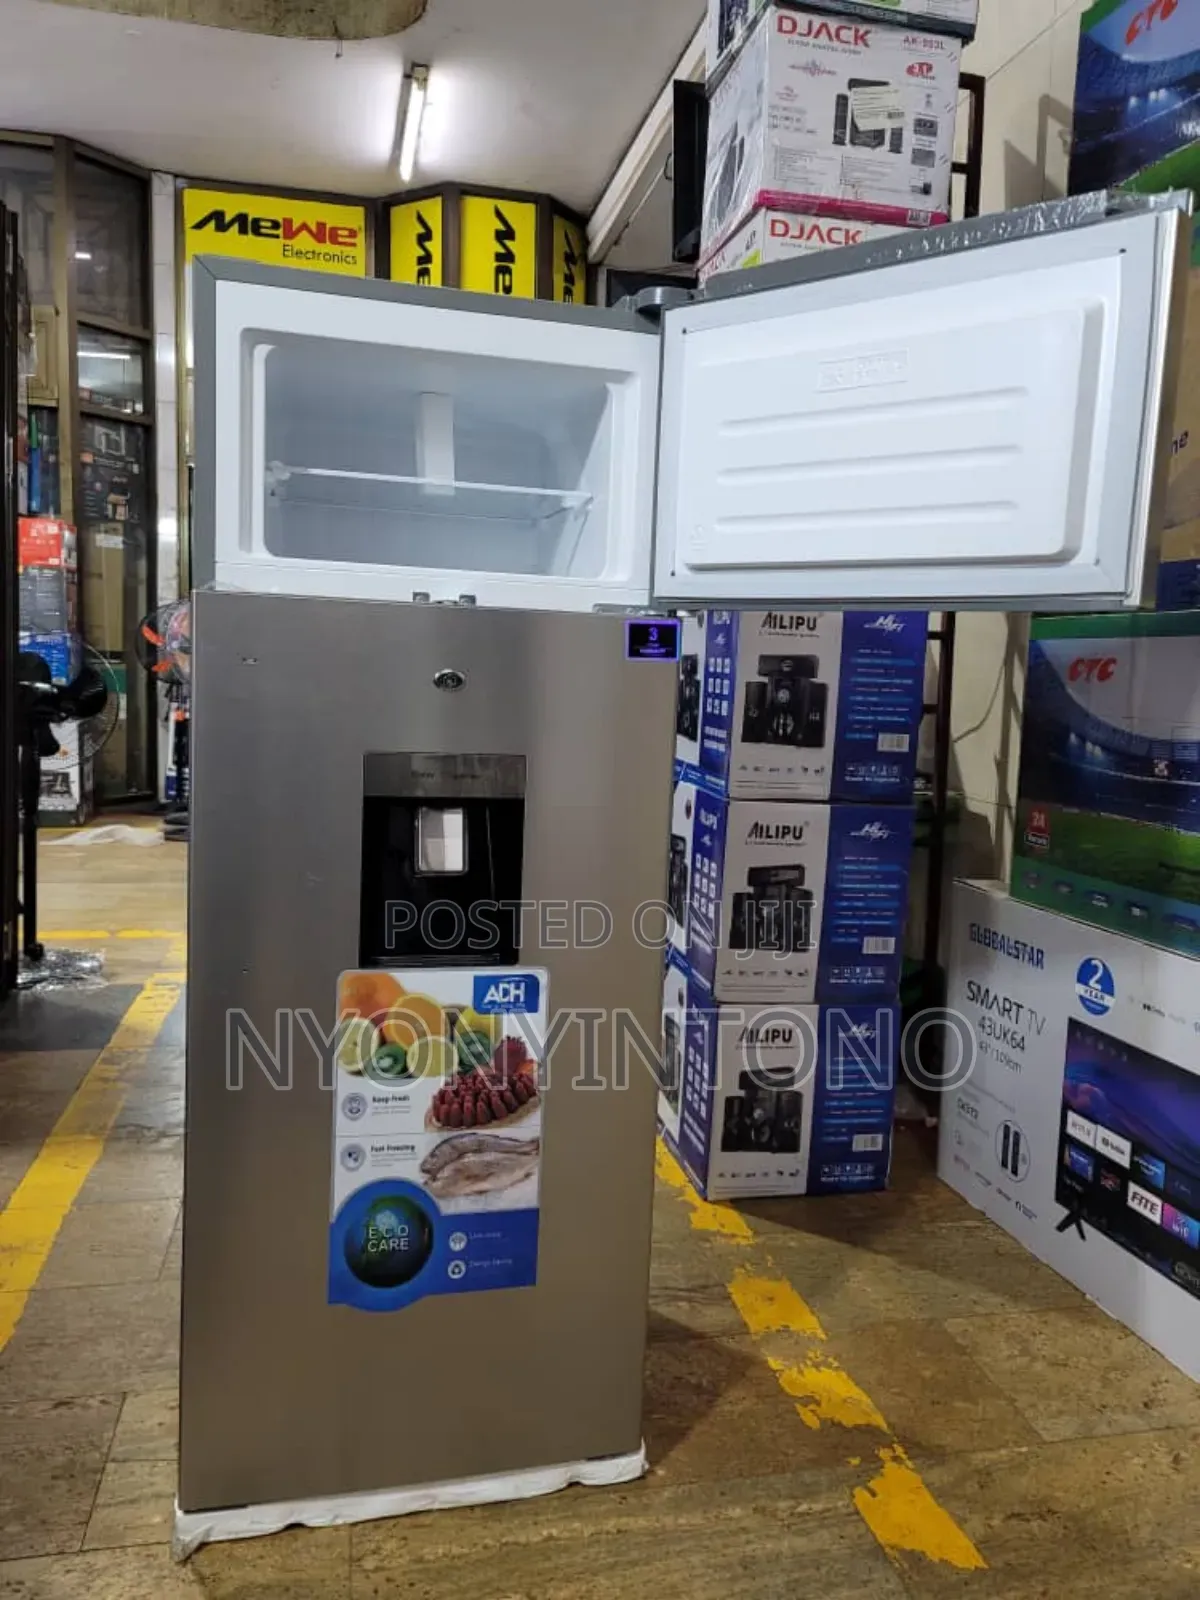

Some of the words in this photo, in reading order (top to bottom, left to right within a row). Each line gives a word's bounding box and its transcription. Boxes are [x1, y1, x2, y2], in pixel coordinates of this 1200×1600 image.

[776, 14, 872, 48] DJACK
[191, 208, 359, 248] MeWe
[769, 218, 863, 246] DJACK
[282, 243, 358, 265] Electronics
[647, 627, 658, 641] 3
[761, 612, 818, 632] AILIPU
[1067, 656, 1118, 682] CTC
[748, 821, 804, 841] AILIPU
[969, 922, 1045, 969] GLOBALSTAR
[1088, 958, 1103, 991] 2
[966, 980, 1024, 1025] SMART
[1027, 1007, 1047, 1036] TV
[977, 1015, 1026, 1051] 43UK64
[1130, 1191, 1160, 1215] FITE
[367, 1237, 410, 1252] CARE
[368, 1225, 409, 1239] ECO
